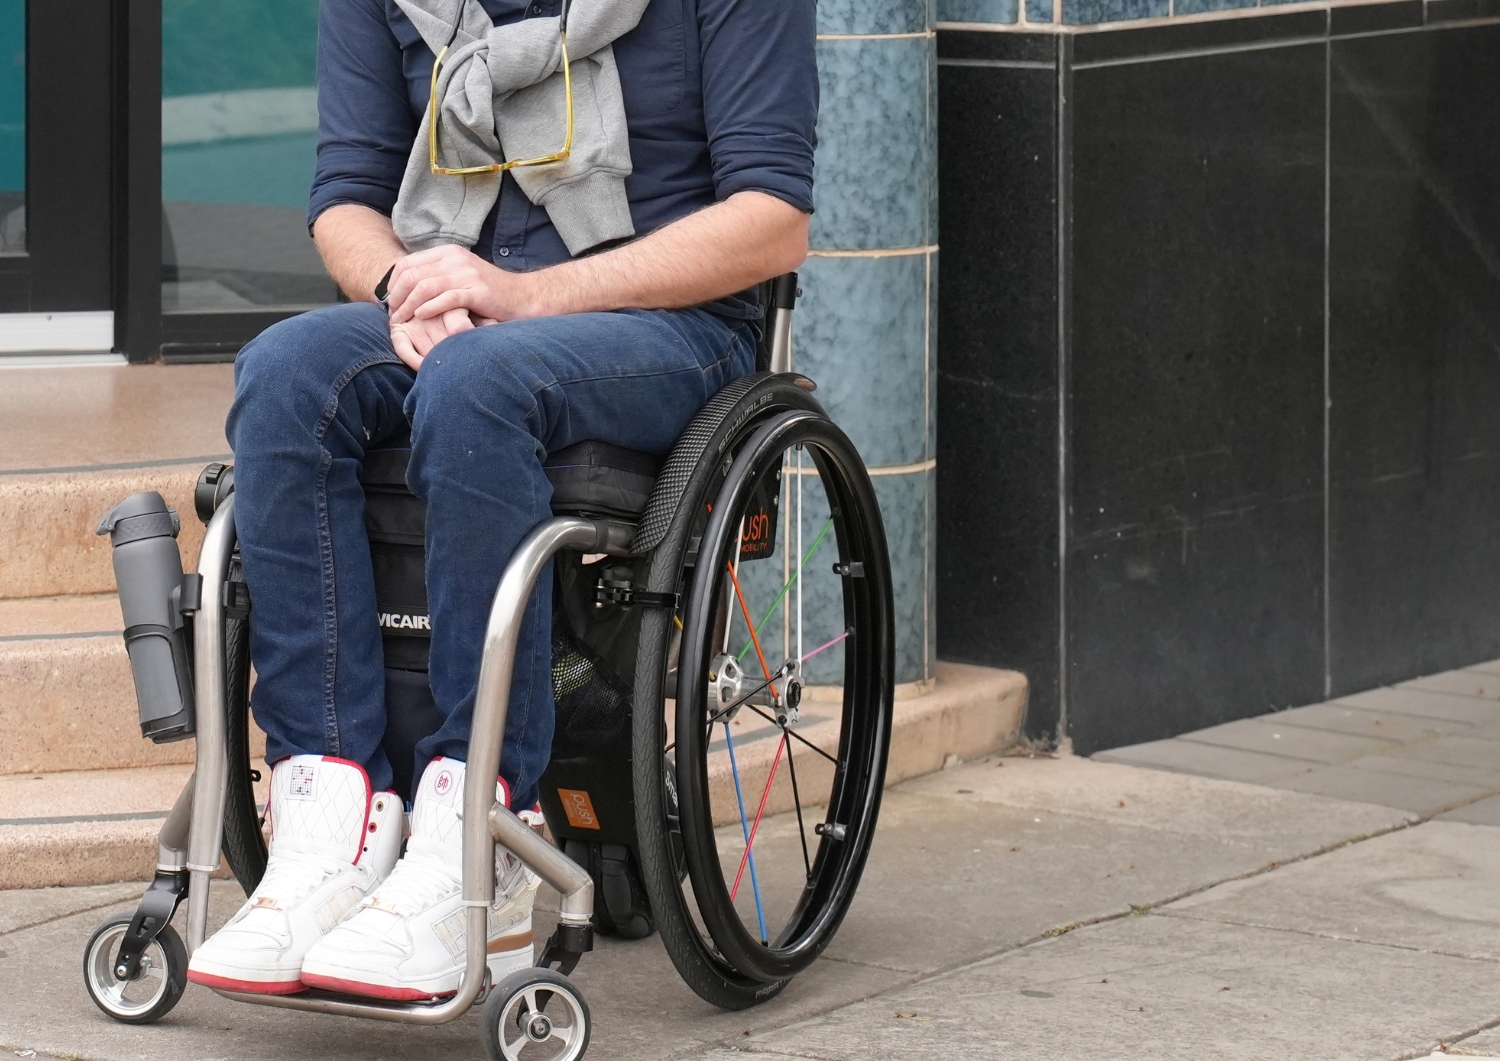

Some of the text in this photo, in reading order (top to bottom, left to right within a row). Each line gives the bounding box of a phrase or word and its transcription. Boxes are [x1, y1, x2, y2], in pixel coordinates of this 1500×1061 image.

[718, 392, 775, 454] SCHWALBE
[734, 507, 769, 542] ush
[740, 542, 768, 552] MOBILITY
[377, 612, 431, 630] VICAIR
[570, 793, 595, 825] push
[755, 978, 787, 1000] MARAT
